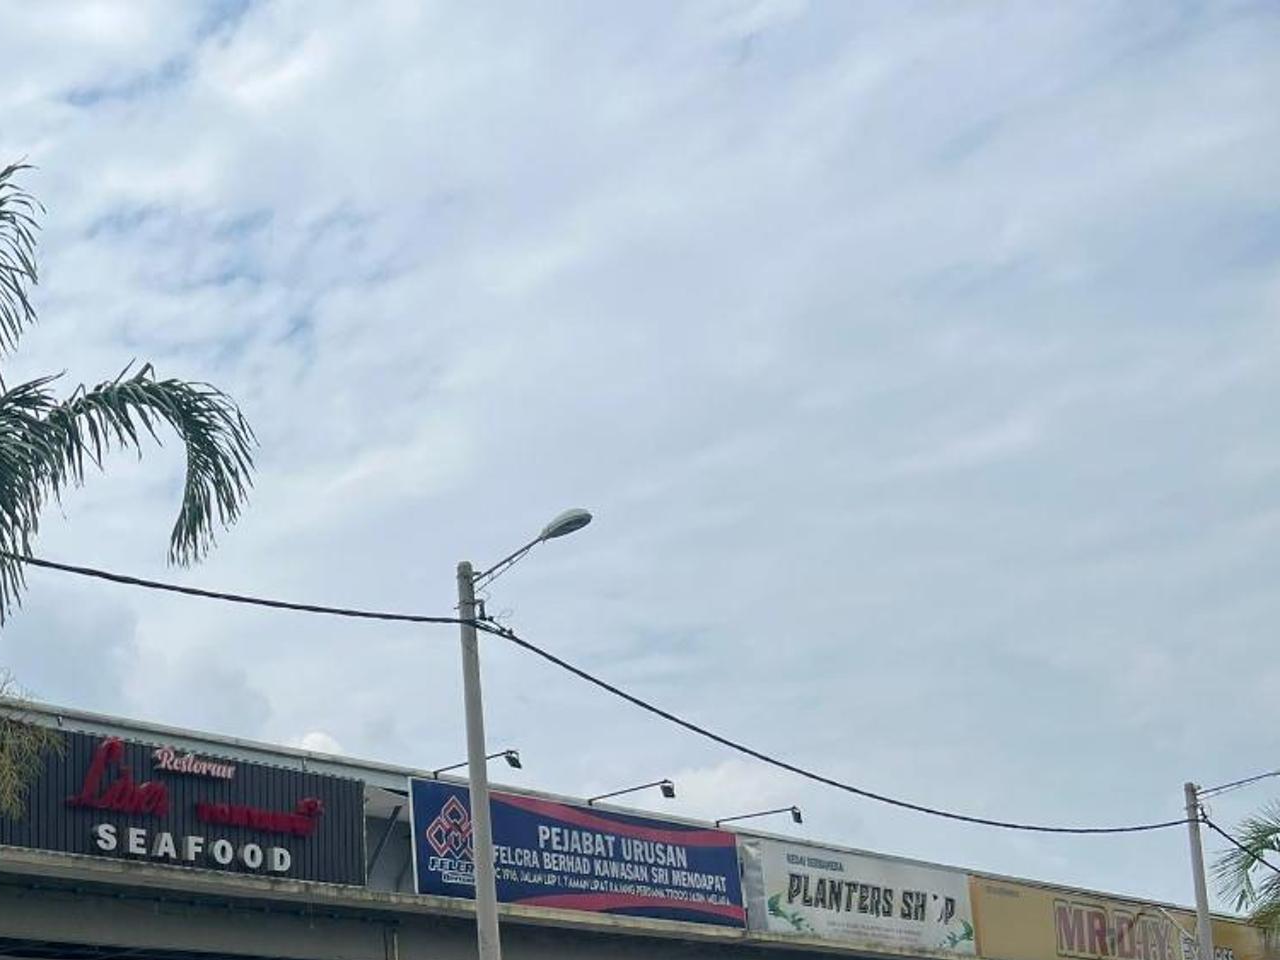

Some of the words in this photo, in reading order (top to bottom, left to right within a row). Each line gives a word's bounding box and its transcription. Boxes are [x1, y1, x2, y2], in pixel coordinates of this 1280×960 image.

[153, 746, 236, 779] Restoran
[96, 823, 291, 872] SEAFOOD
[428, 856, 475, 873] FELCR
[494, 845, 540, 868] FELCRA
[543, 851, 591, 875] BERHAD
[594, 859, 648, 882] KAWASAN
[651, 866, 669, 885] SRI
[671, 870, 727, 892] MENDAPAT
[537, 824, 616, 858] PEJABAT
[622, 837, 688, 868] URUSAN
[787, 873, 894, 918] PLANTERS
[900, 889, 956, 925] SHP
